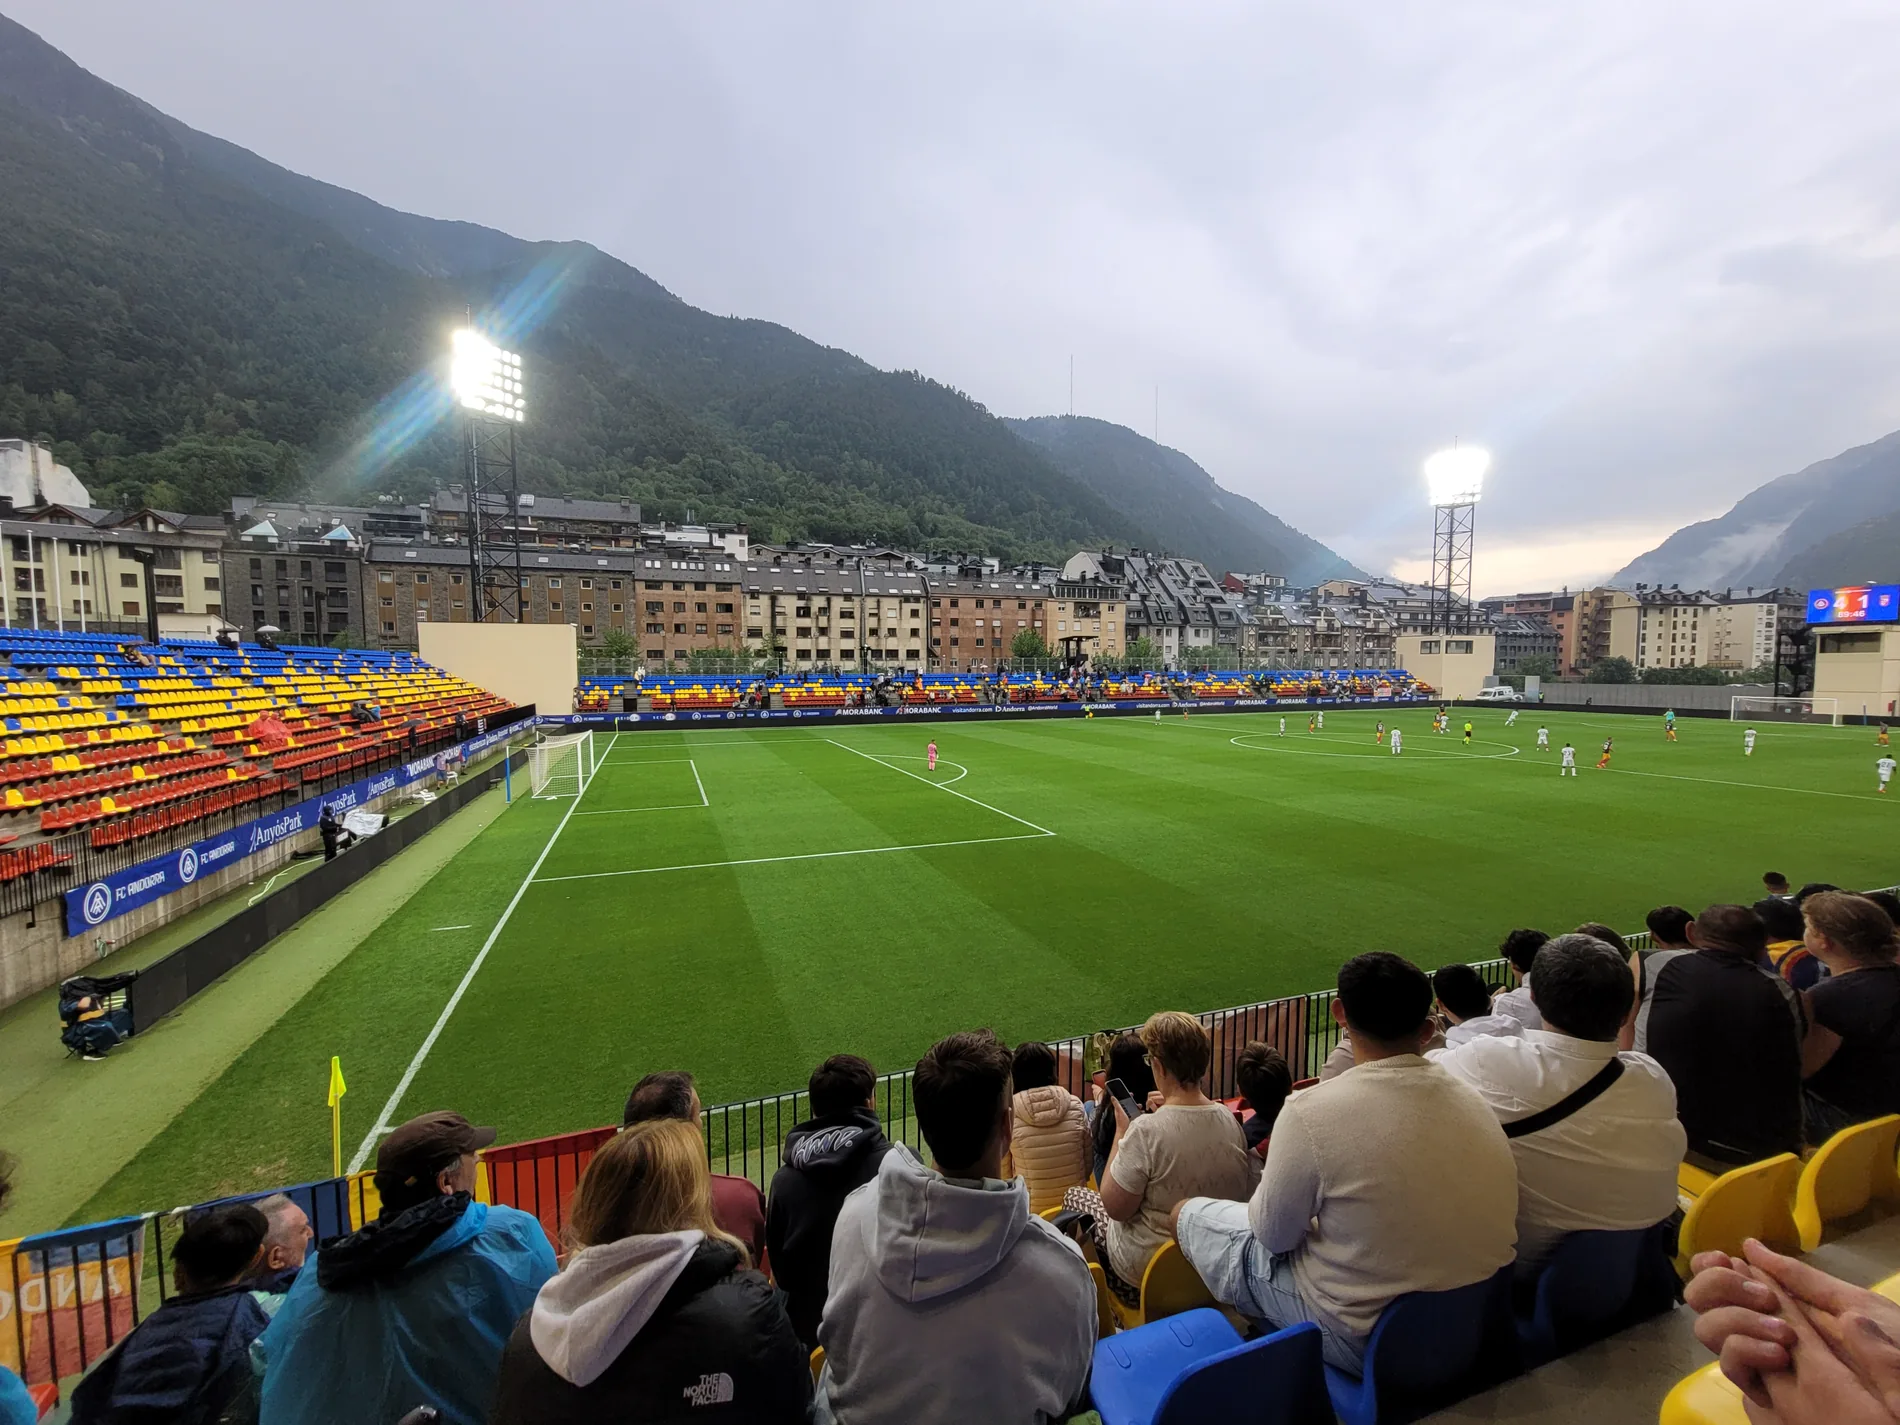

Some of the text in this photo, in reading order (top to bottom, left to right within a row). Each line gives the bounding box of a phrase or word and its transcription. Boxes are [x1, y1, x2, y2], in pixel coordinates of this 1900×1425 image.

[1833, 595, 1868, 609] 4 1
[842, 707, 883, 716] MORABANC
[952, 706, 993, 714] visitandorra.com
[256, 811, 303, 845] AnyósPark
[200, 841, 235, 865] FC ANDORRA
[115, 870, 166, 902] FC ANDORRA
[699, 1373, 719, 1386] THE
[683, 1384, 718, 1398] NORTH
[692, 1394, 719, 1407] FACE
